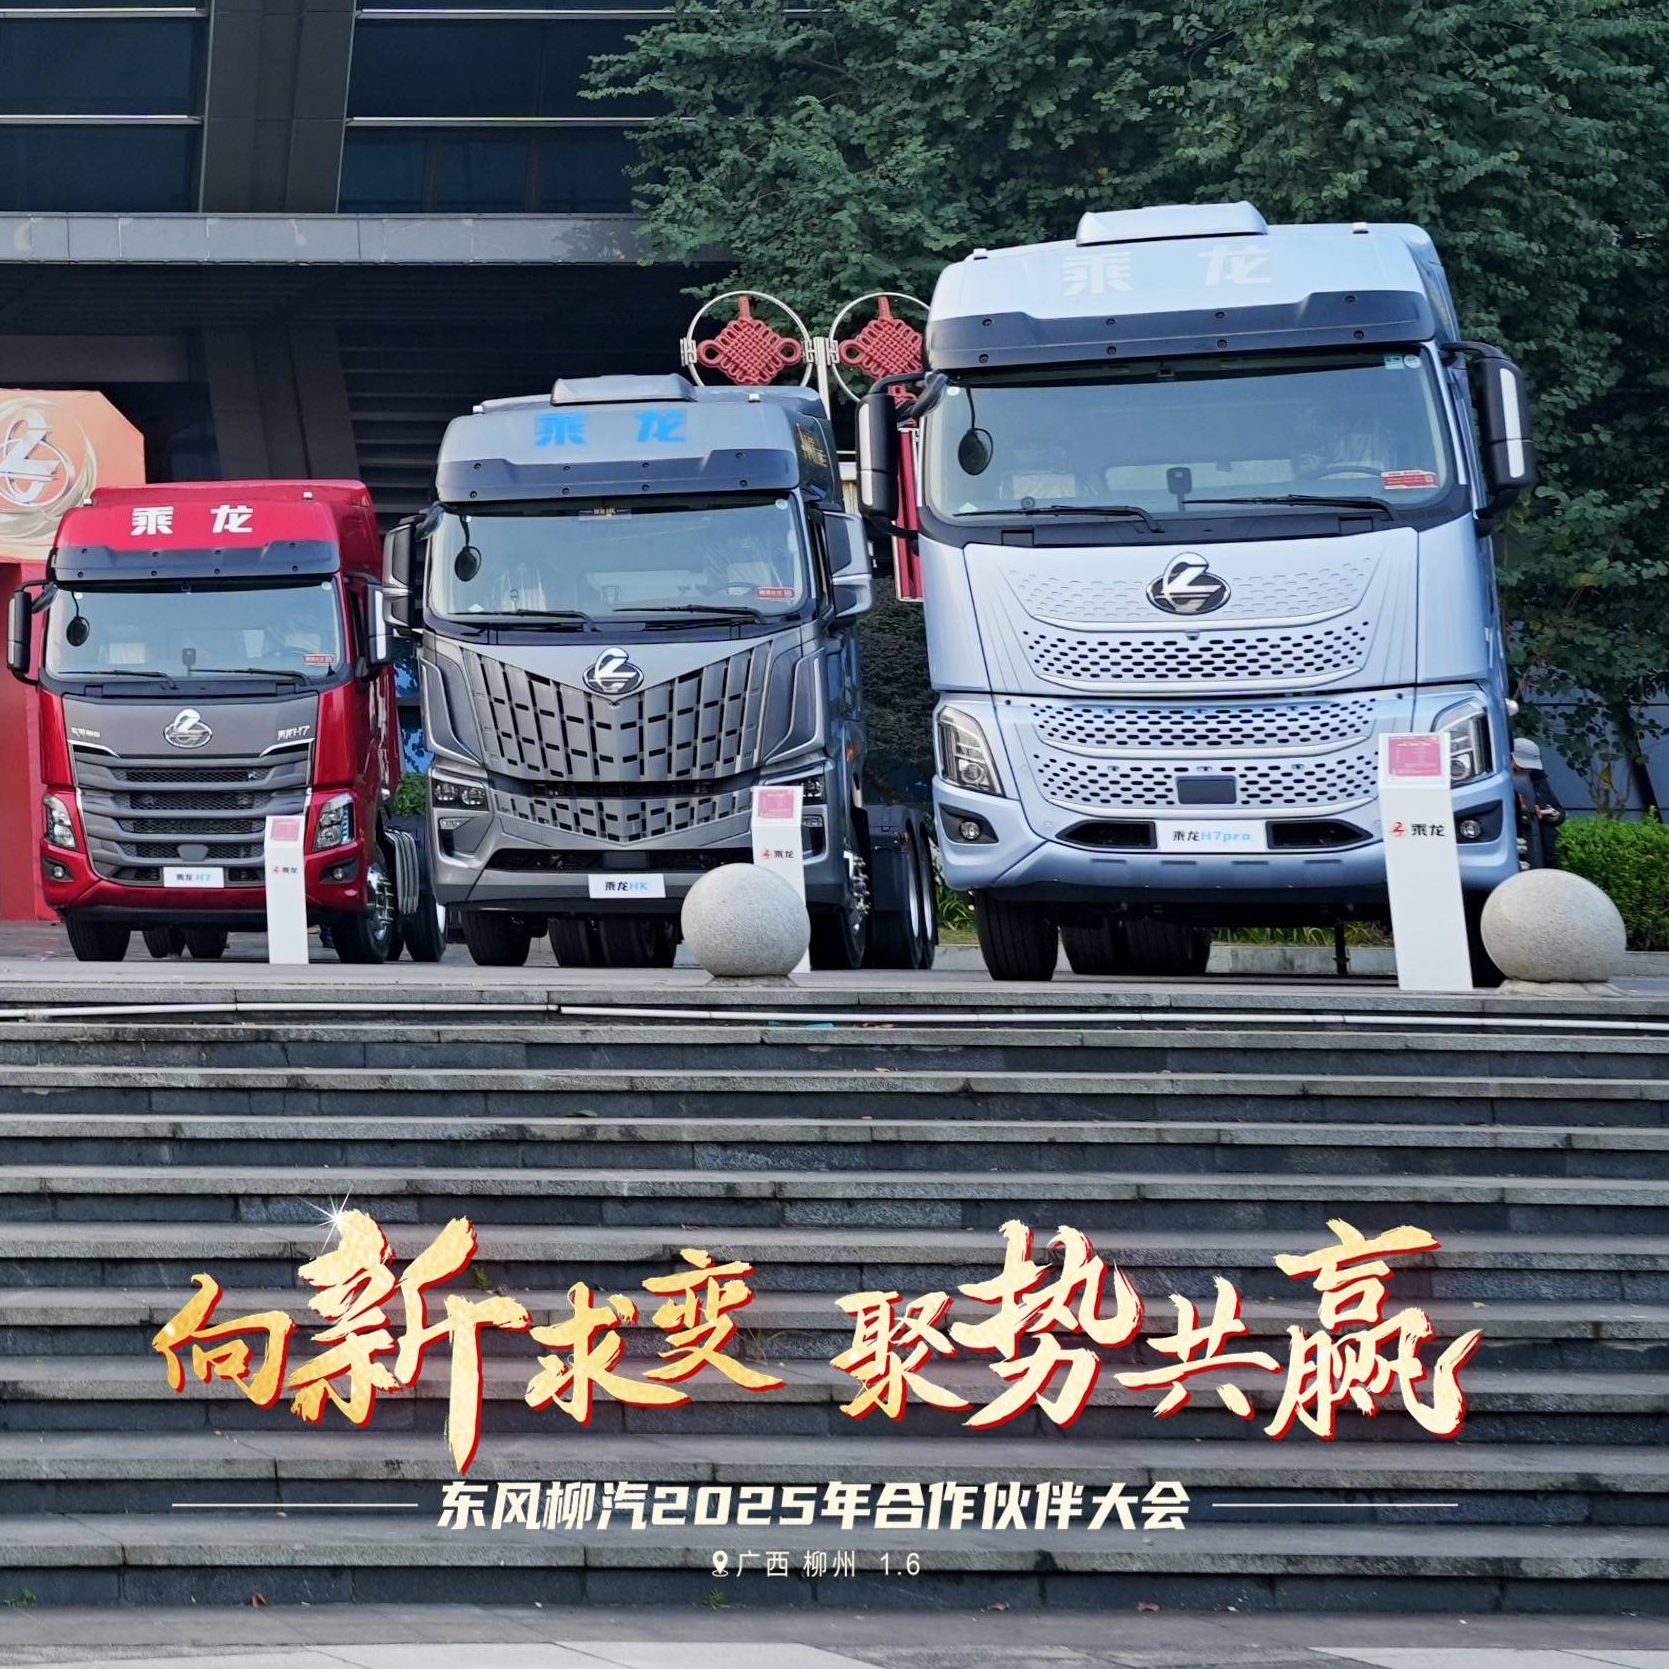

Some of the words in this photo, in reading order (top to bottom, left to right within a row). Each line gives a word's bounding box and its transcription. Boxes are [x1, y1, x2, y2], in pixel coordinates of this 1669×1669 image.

[1063, 245, 1272, 296] 乘龙
[534, 410, 687, 447] 乘龙
[131, 505, 254, 535] 乘龙
